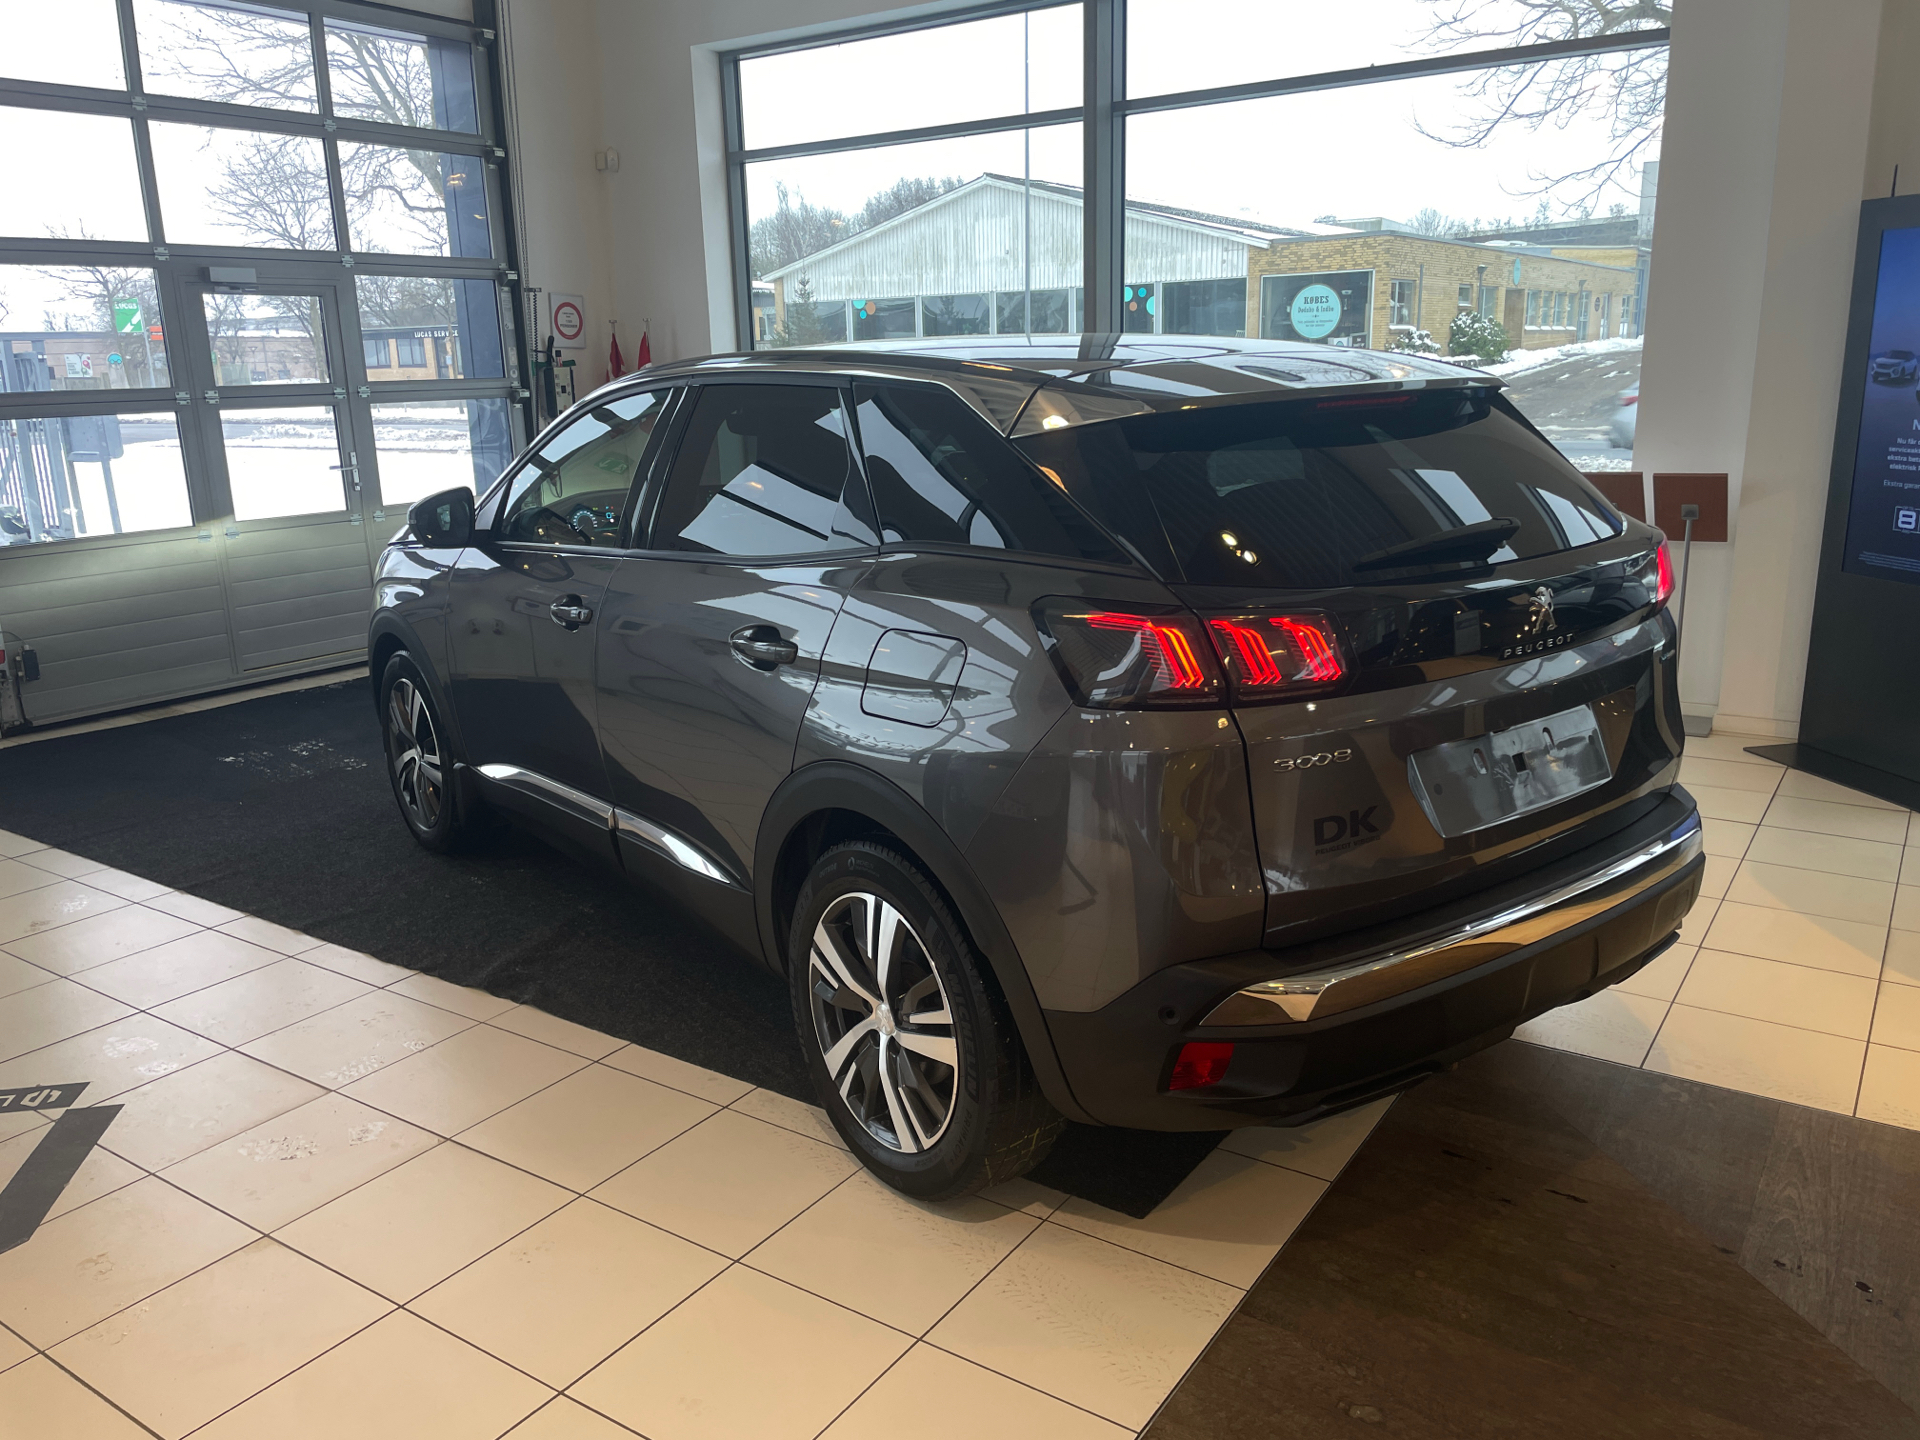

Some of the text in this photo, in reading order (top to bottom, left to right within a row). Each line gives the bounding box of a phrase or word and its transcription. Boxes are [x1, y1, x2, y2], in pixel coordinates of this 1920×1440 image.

[414, 329, 459, 338] LUCAS SERVCE
[1503, 633, 1573, 658] PEUGEOT
[1273, 748, 1353, 773] 3008
[1313, 804, 1380, 847] DK
[1315, 841, 1352, 856] PEUGEOT
[946, 972, 979, 1100] MICHELIN
